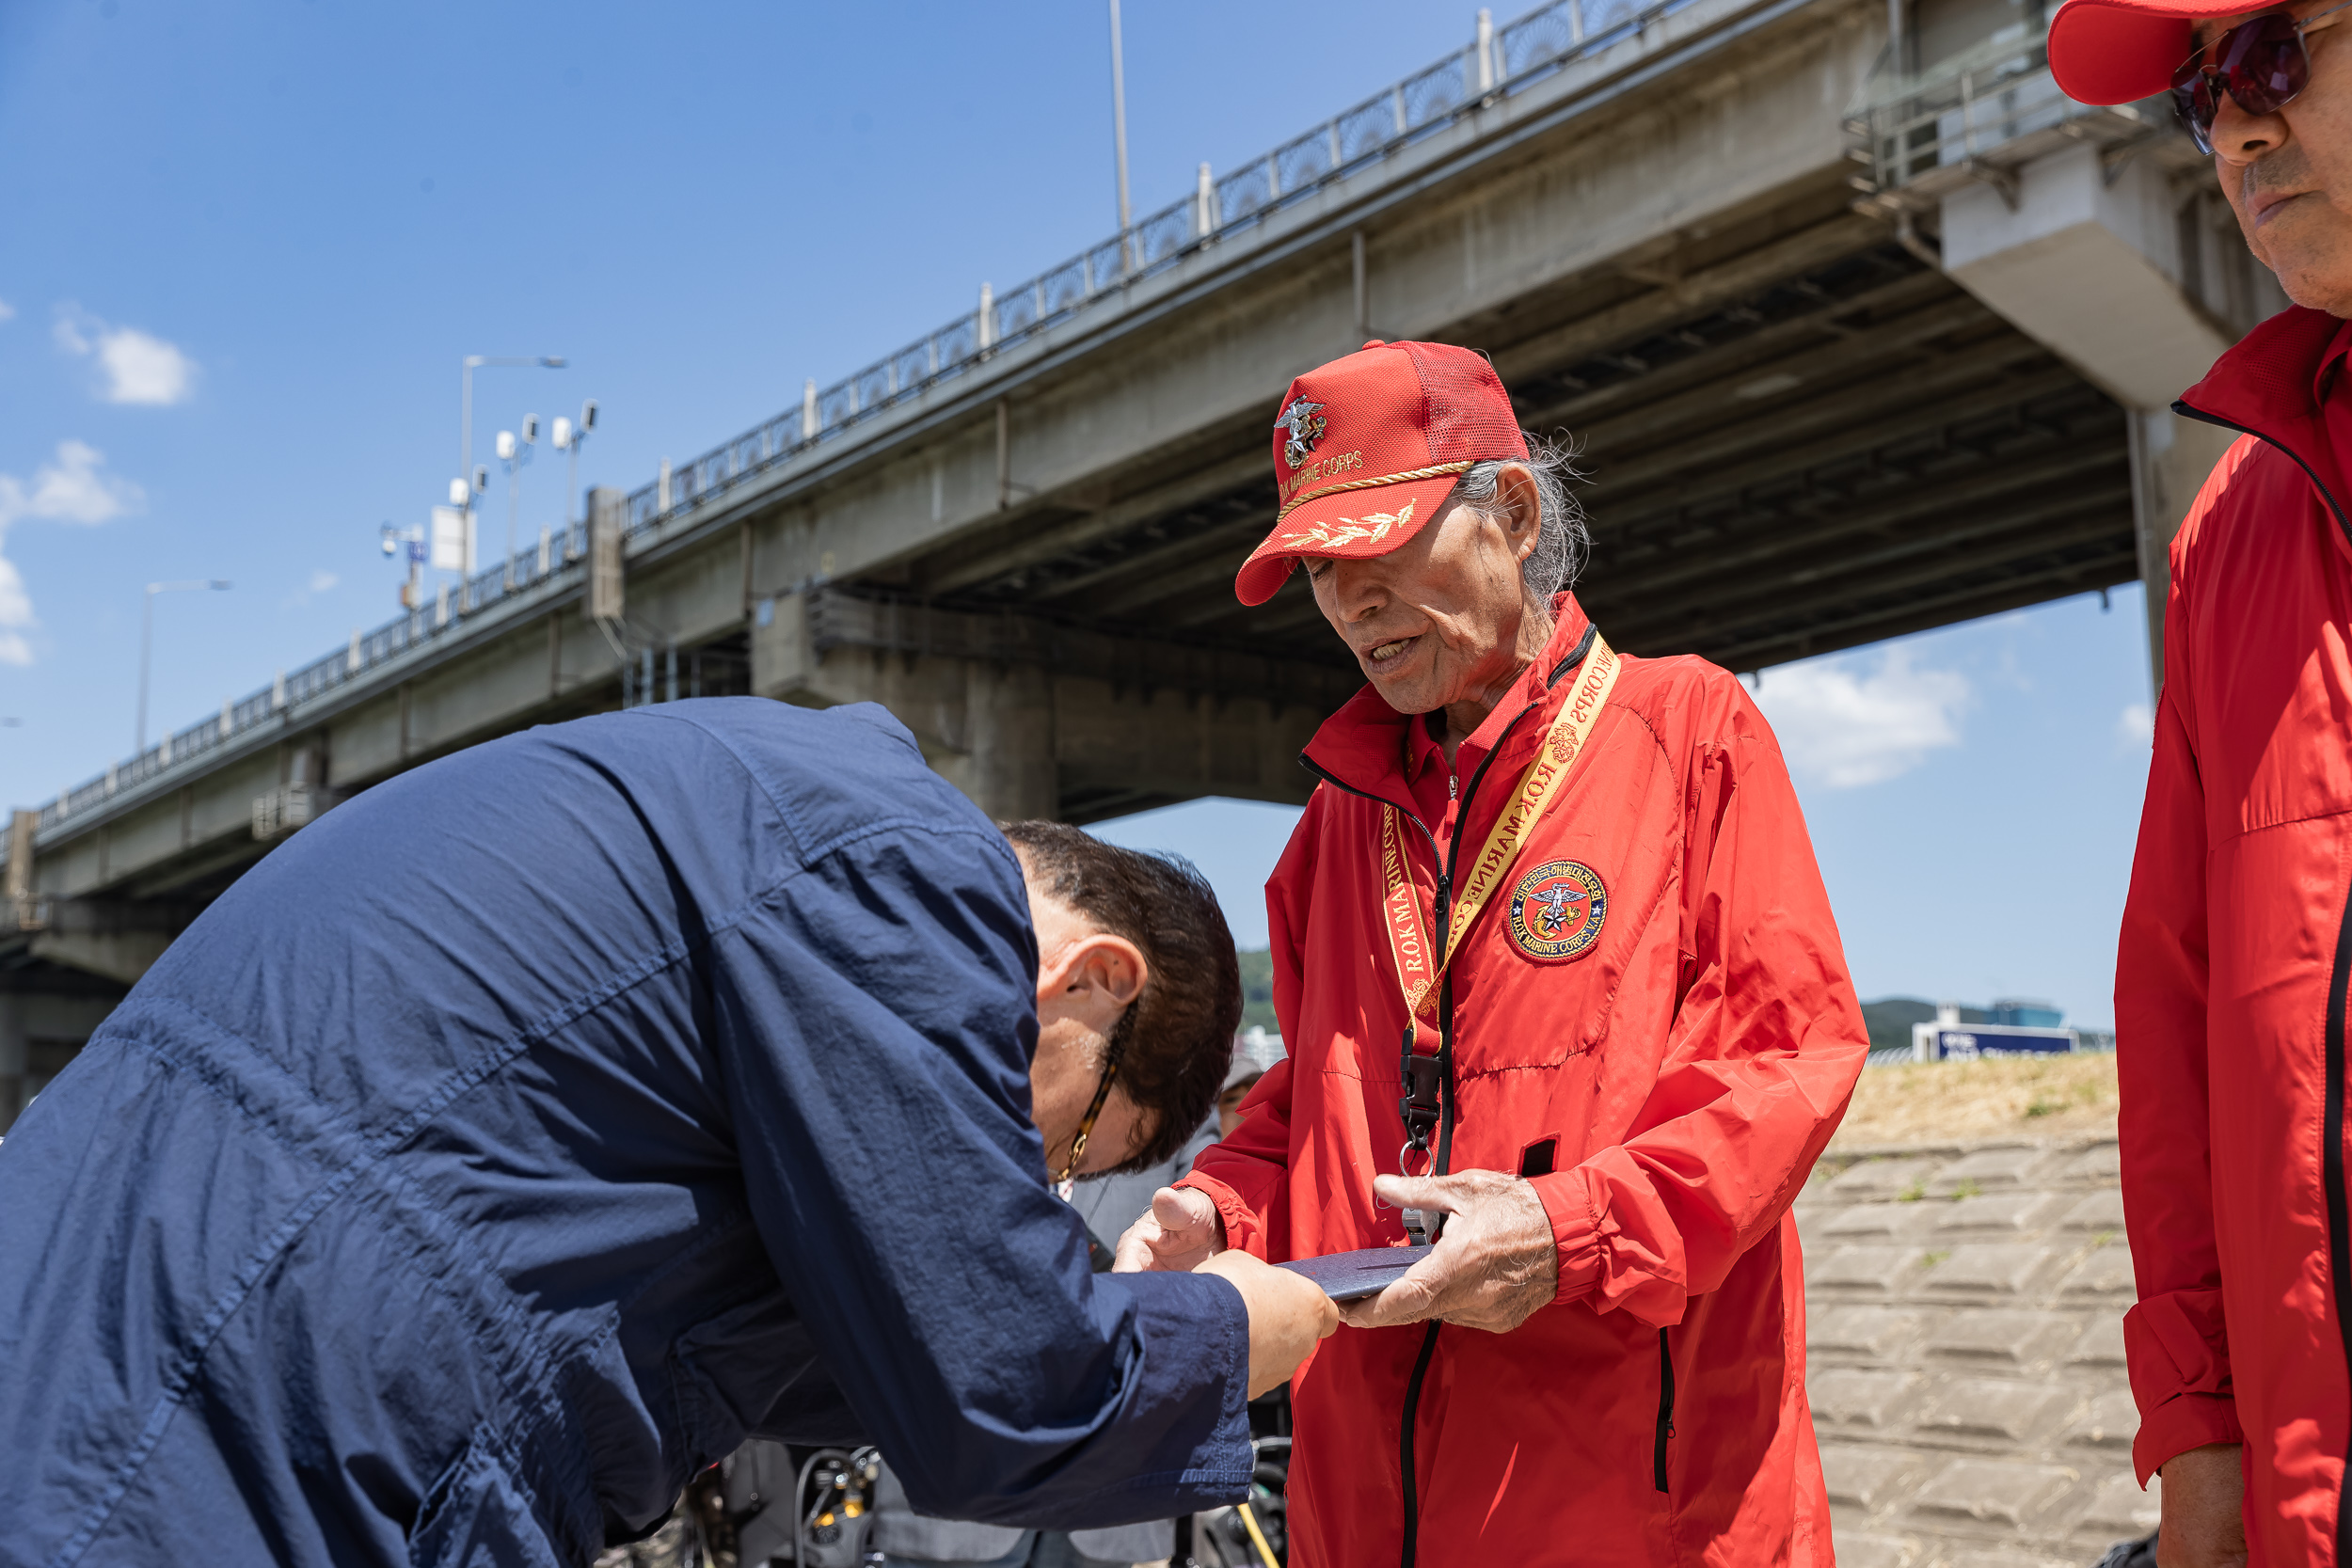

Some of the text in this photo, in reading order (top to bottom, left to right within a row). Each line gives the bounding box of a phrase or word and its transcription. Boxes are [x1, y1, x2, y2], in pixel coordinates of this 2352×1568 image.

[1290, 463, 1321, 492] MARINE
[1323, 450, 1363, 478] CORPS
[1385, 844, 1413, 927] MARINE
[1397, 927, 1424, 974] R.O.K
[1522, 934, 1558, 954] MARINE
[1559, 929, 1592, 953] CORPS
